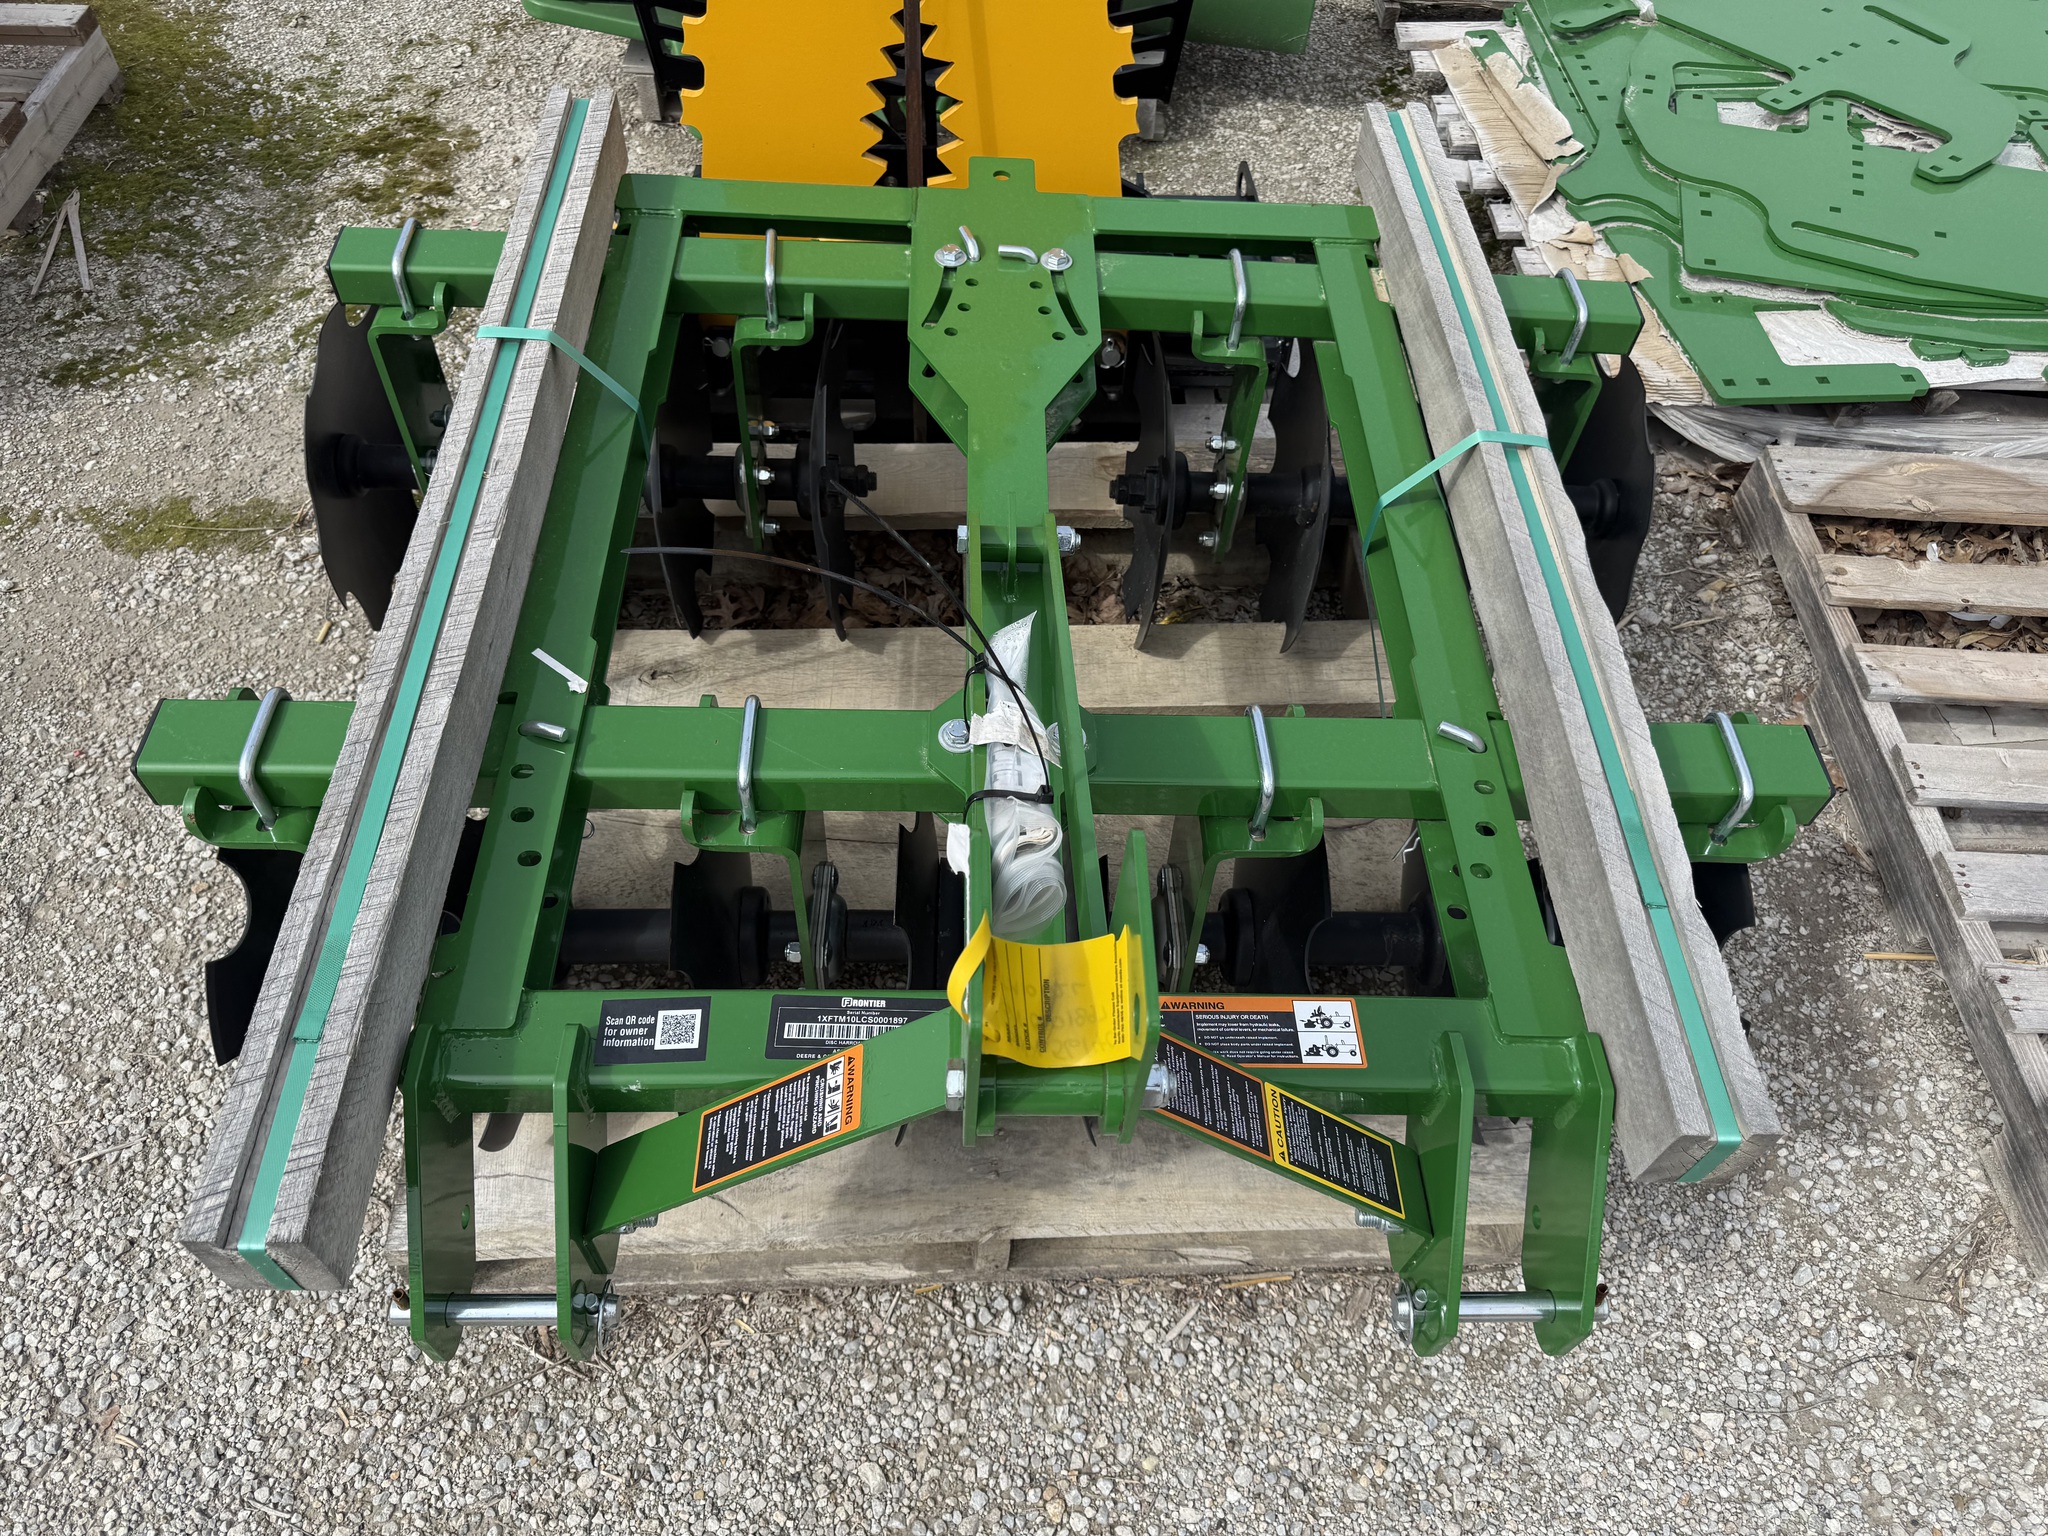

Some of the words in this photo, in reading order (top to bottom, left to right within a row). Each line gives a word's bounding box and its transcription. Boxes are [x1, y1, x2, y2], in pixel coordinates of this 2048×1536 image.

[841, 997, 886, 1008] FRONTIER
[1170, 1002, 1225, 1010] WARNING
[606, 1016, 624, 1025] Scan
[625, 1015, 636, 1025] QR
[638, 1015, 655, 1025] code
[817, 1015, 908, 1024] 1XFTM10LCS0001897
[604, 1027, 618, 1036] for
[620, 1027, 648, 1036] owner
[603, 1037, 655, 1047] information
[1038, 1023, 1046, 1053] CONTROL
[845, 1066, 855, 1125] WARNING
[1270, 1088, 1284, 1148] CAUTION
